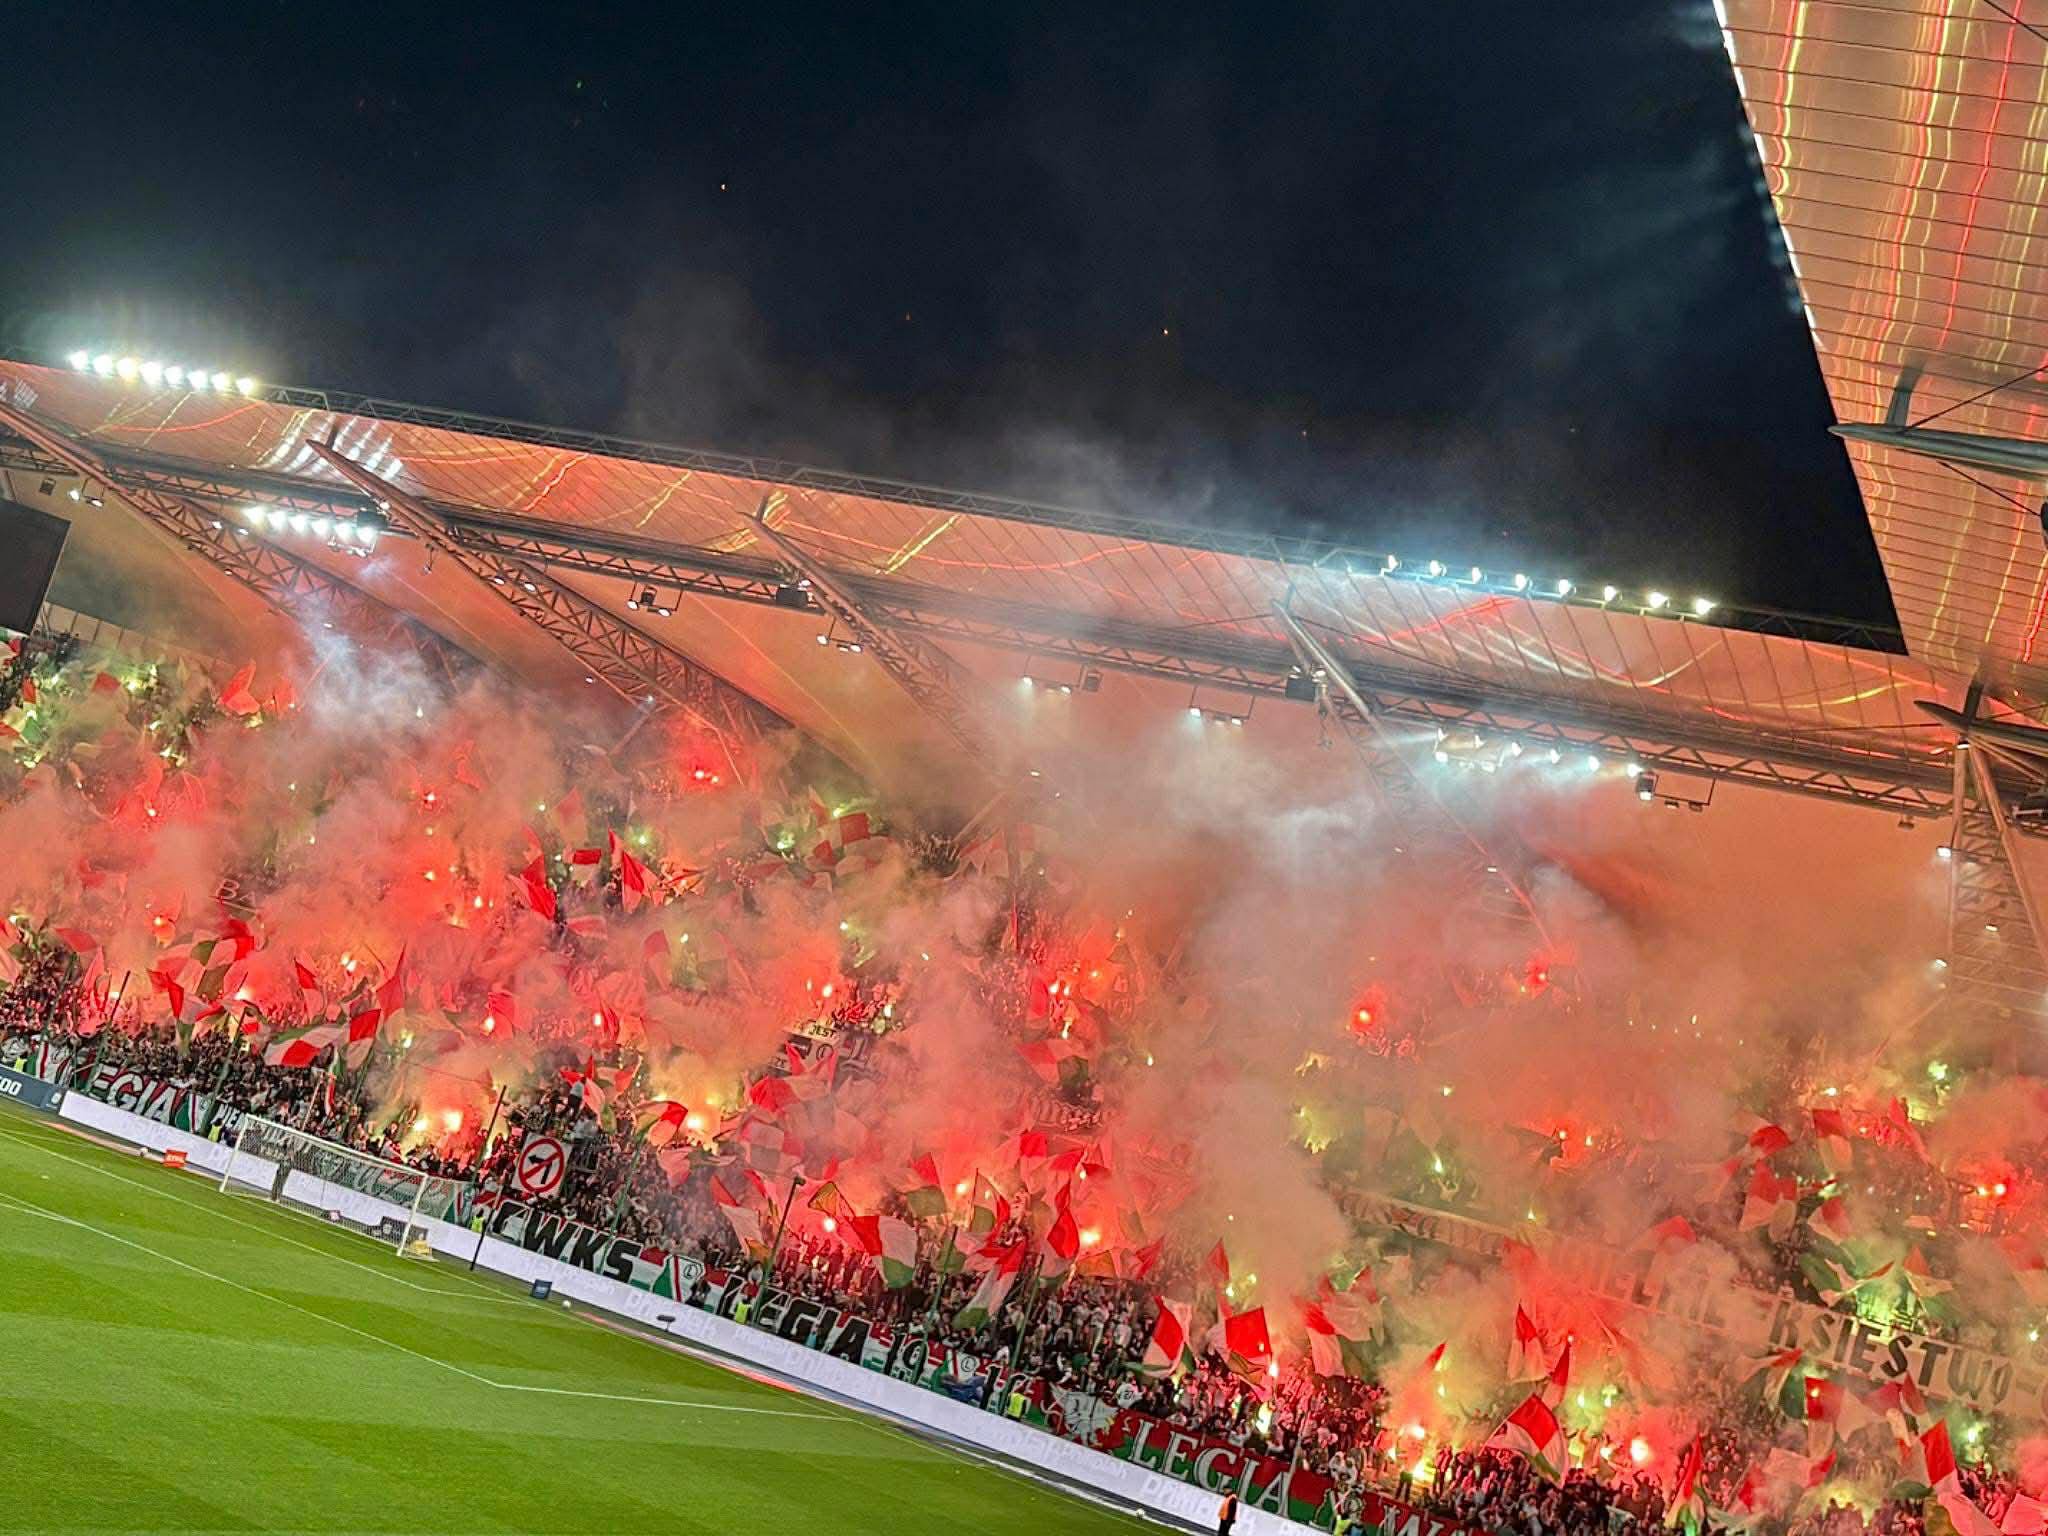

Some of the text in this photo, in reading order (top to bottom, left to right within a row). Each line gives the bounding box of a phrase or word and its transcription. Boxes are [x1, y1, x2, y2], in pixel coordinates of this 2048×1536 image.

[809, 1024, 838, 1038] JEST
[0, 1077, 22, 1096] 00
[84, 1062, 172, 1124] EGIA
[489, 1200, 644, 1284] CWKS
[1128, 1419, 1290, 1517] LEGIA
